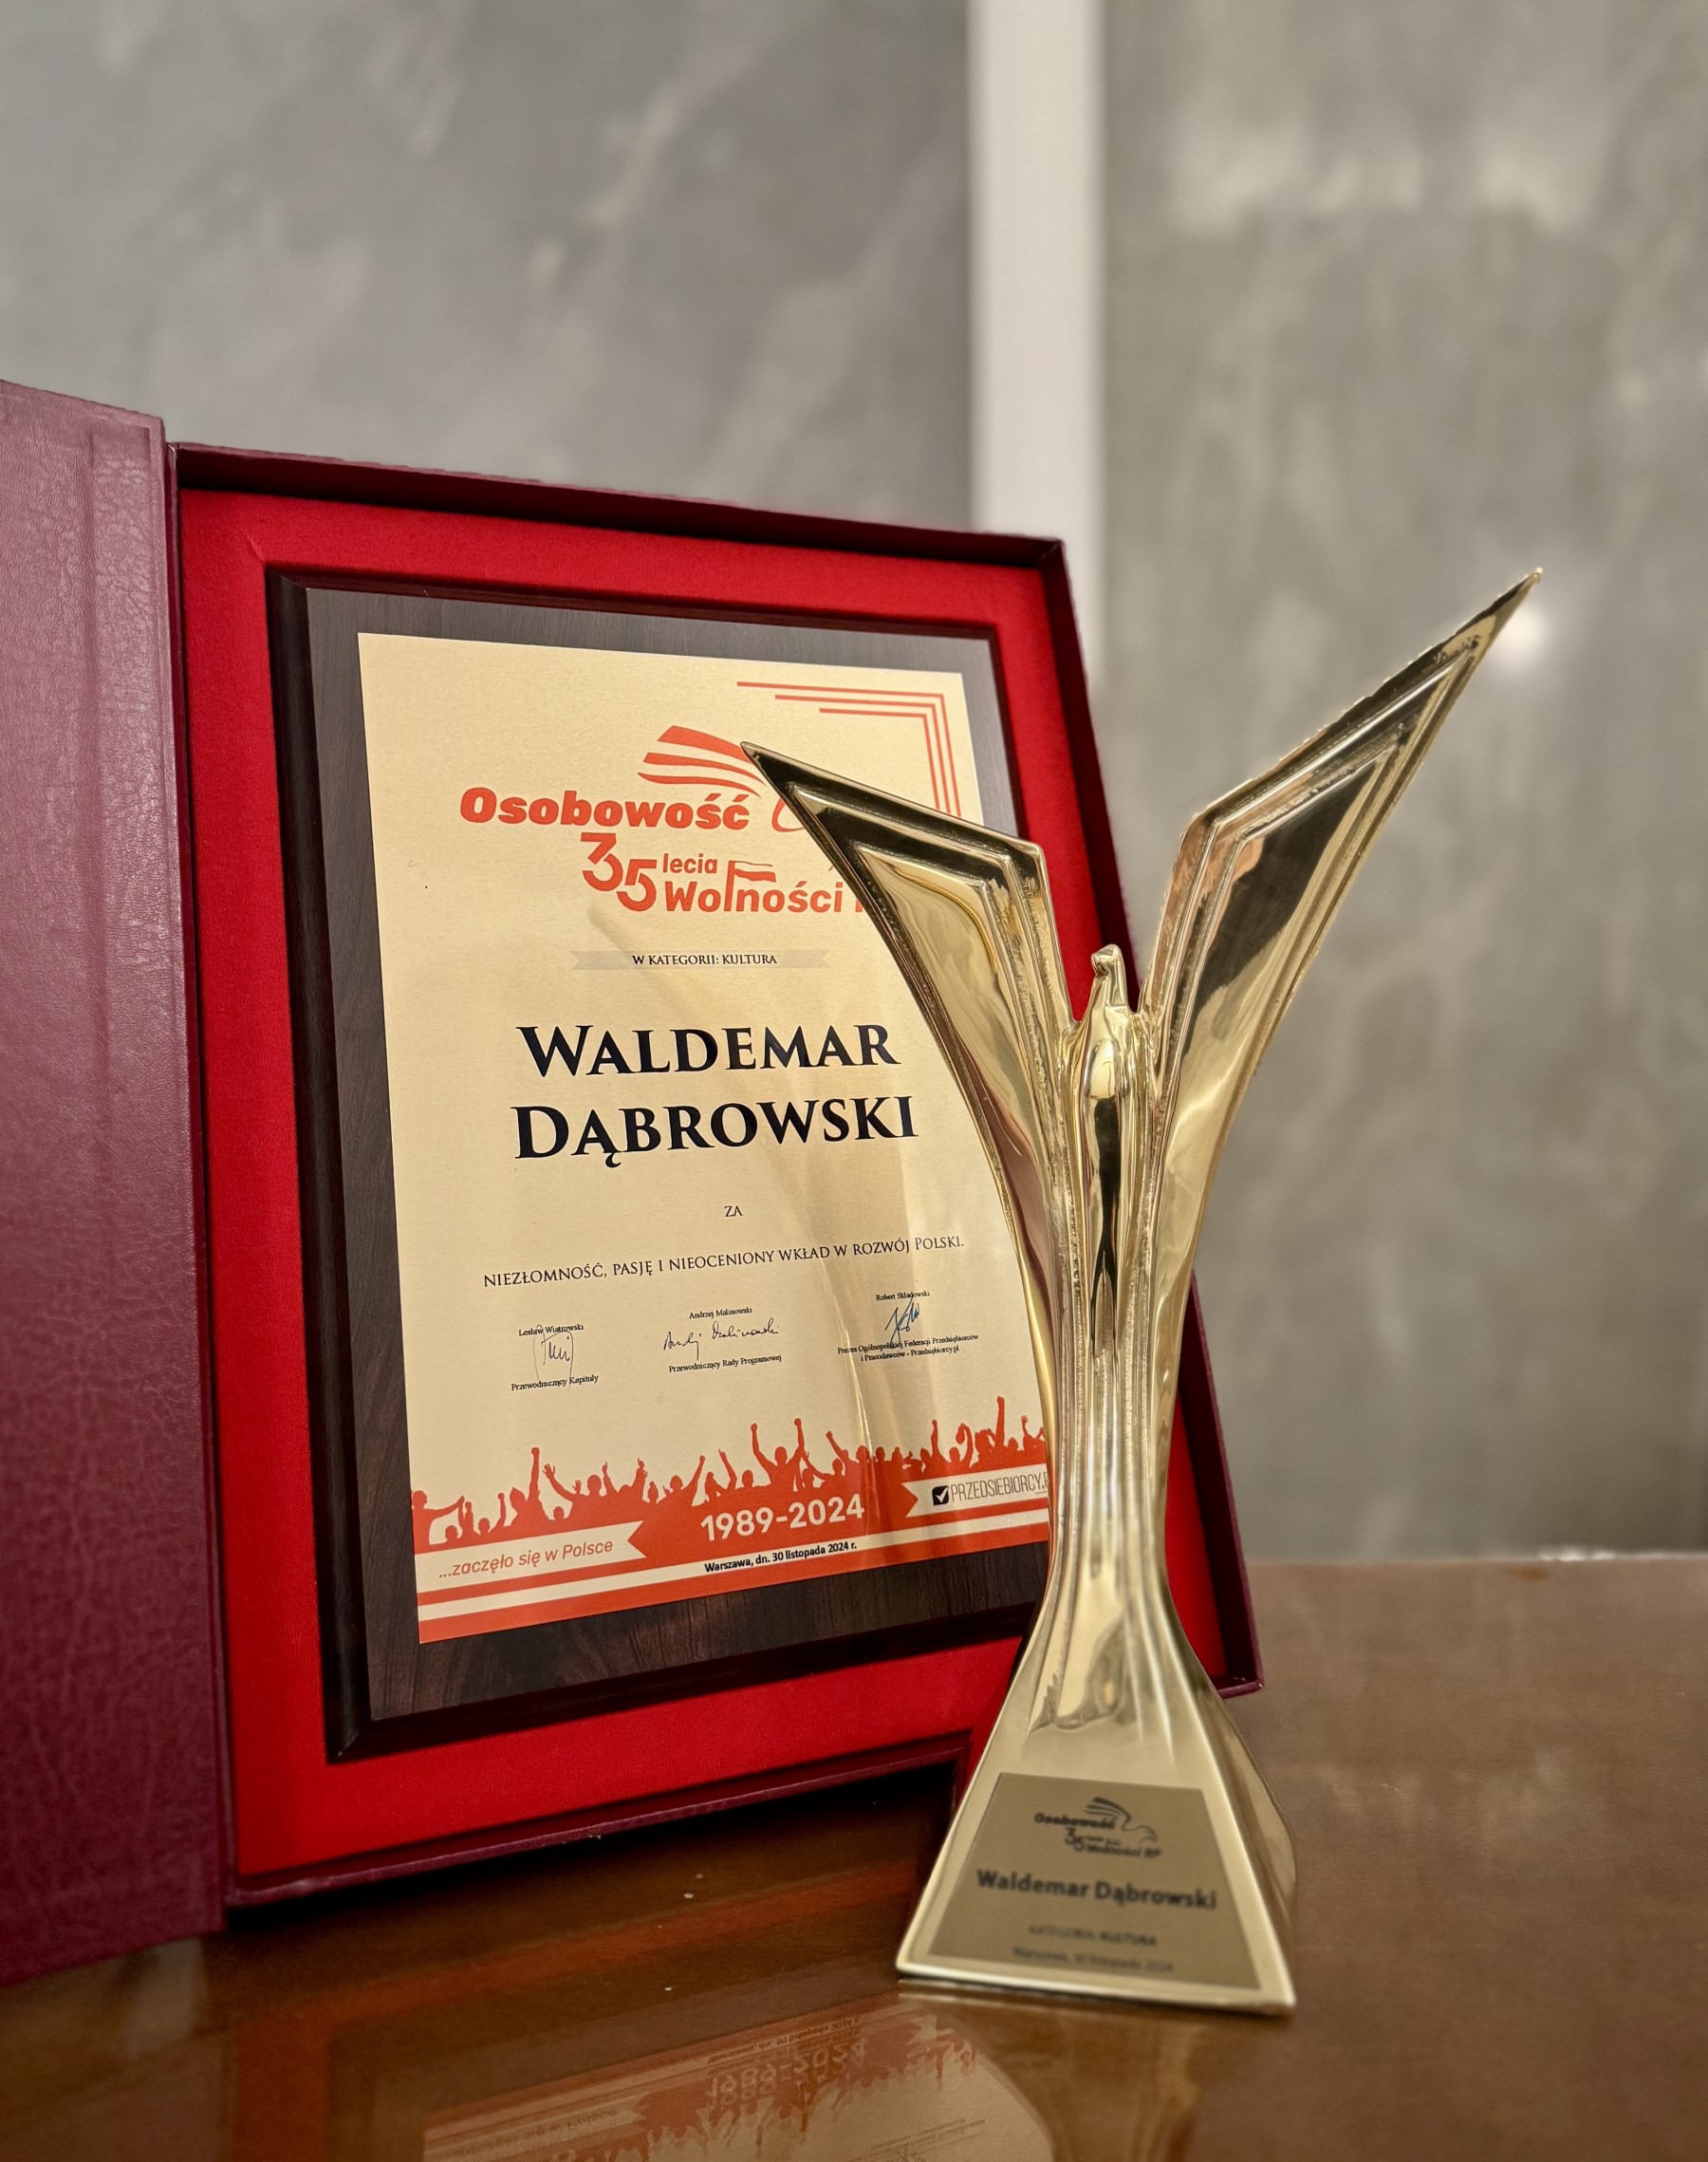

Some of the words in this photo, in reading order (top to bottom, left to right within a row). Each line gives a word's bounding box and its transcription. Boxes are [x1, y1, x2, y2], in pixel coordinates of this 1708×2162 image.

[460, 787, 751, 830] Osobowość
[580, 831, 658, 912] 35
[662, 852, 718, 874] lecia
[664, 861, 844, 913] Wolności
[632, 955, 645, 965] W
[649, 954, 719, 965] KATEGORII:
[722, 953, 778, 964] KULTURA
[515, 1024, 901, 1078] WALDEMAR
[511, 1095, 919, 1168] DĄBROWSKI
[724, 1205, 743, 1217] ZA
[484, 1262, 607, 1287] NIEZŁOMNOŚĆ,
[612, 1260, 654, 1277] PASJĘ
[659, 1258, 664, 1272] I
[669, 1250, 775, 1271] NIEOCENIONY
[778, 1246, 830, 1262] WKŁAD
[833, 1245, 848, 1258] W
[853, 1238, 910, 1256] ROZWÓJ
[689, 1311, 715, 1319] Andrzej
[716, 1306, 753, 1316] Malinowski
[722, 1358, 739, 1368] Rady
[740, 1354, 782, 1366] Programowej
[700, 1493, 865, 1541] 1989-2024
[438, 1554, 514, 1578] ...zaczęło
[518, 1549, 541, 1567] się
[545, 1549, 559, 1562] w
[562, 1538, 614, 1559] Polsce
[704, 1557, 754, 1573] Warszawa,
[755, 1553, 770, 1565] dn.
[772, 1551, 784, 1562] 30
[785, 1545, 826, 1560] listopada
[827, 1541, 849, 1554] 2024
[850, 1541, 858, 1550] r.
[976, 1868, 1090, 1899] Waldemar
[1095, 1880, 1217, 1910] Dąbrowski
